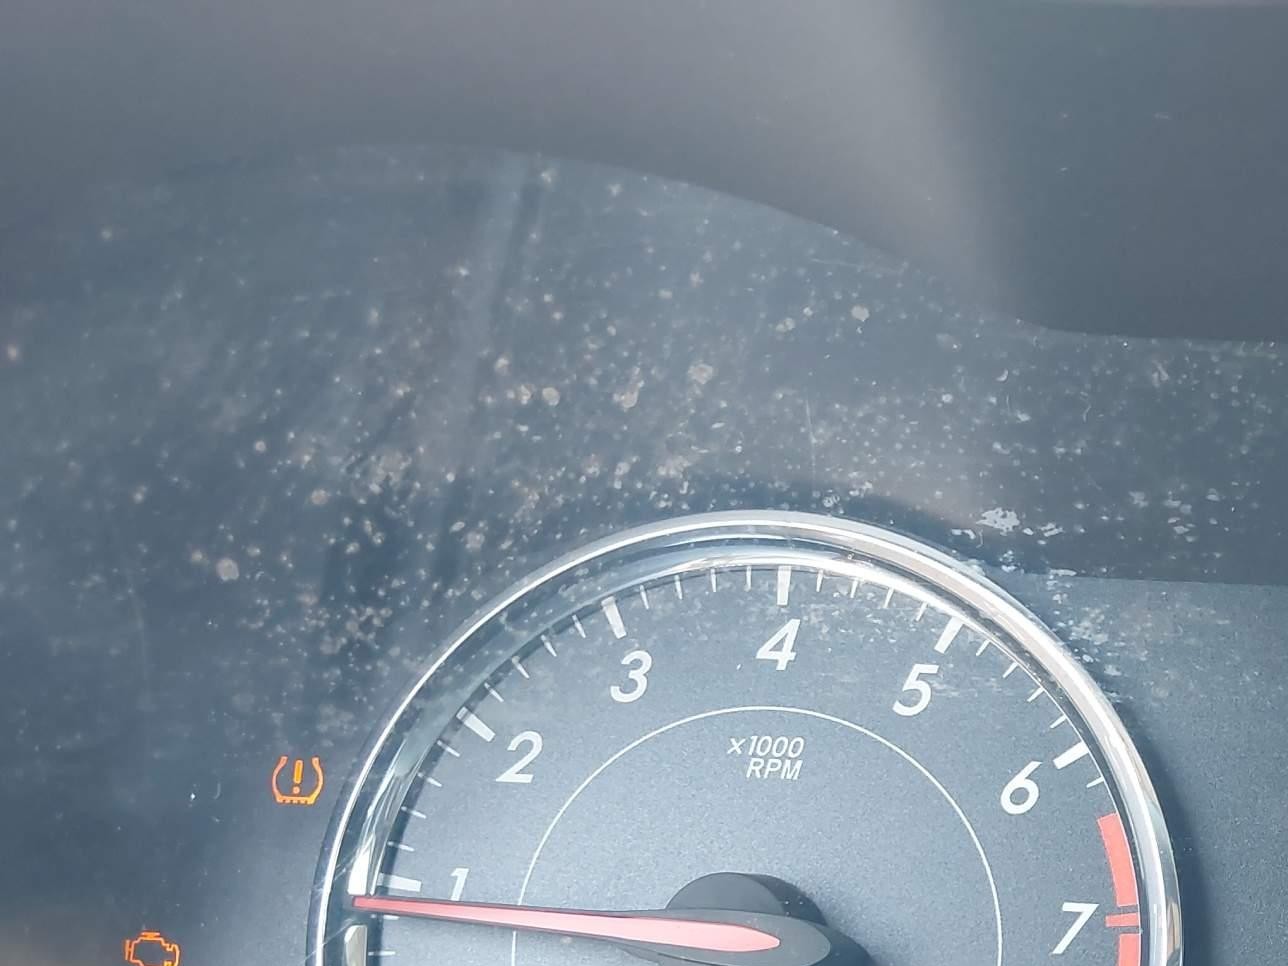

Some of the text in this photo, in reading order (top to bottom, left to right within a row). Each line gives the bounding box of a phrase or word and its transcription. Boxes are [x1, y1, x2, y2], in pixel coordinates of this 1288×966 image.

[756, 618, 801, 670] 4
[610, 650, 652, 702] 3
[892, 663, 938, 716] 5
[495, 731, 543, 783] 2
[727, 735, 804, 757] x1000
[746, 758, 802, 781] RPM
[1000, 761, 1042, 815] 6
[451, 867, 470, 901] 1
[1052, 902, 1099, 955] 7
